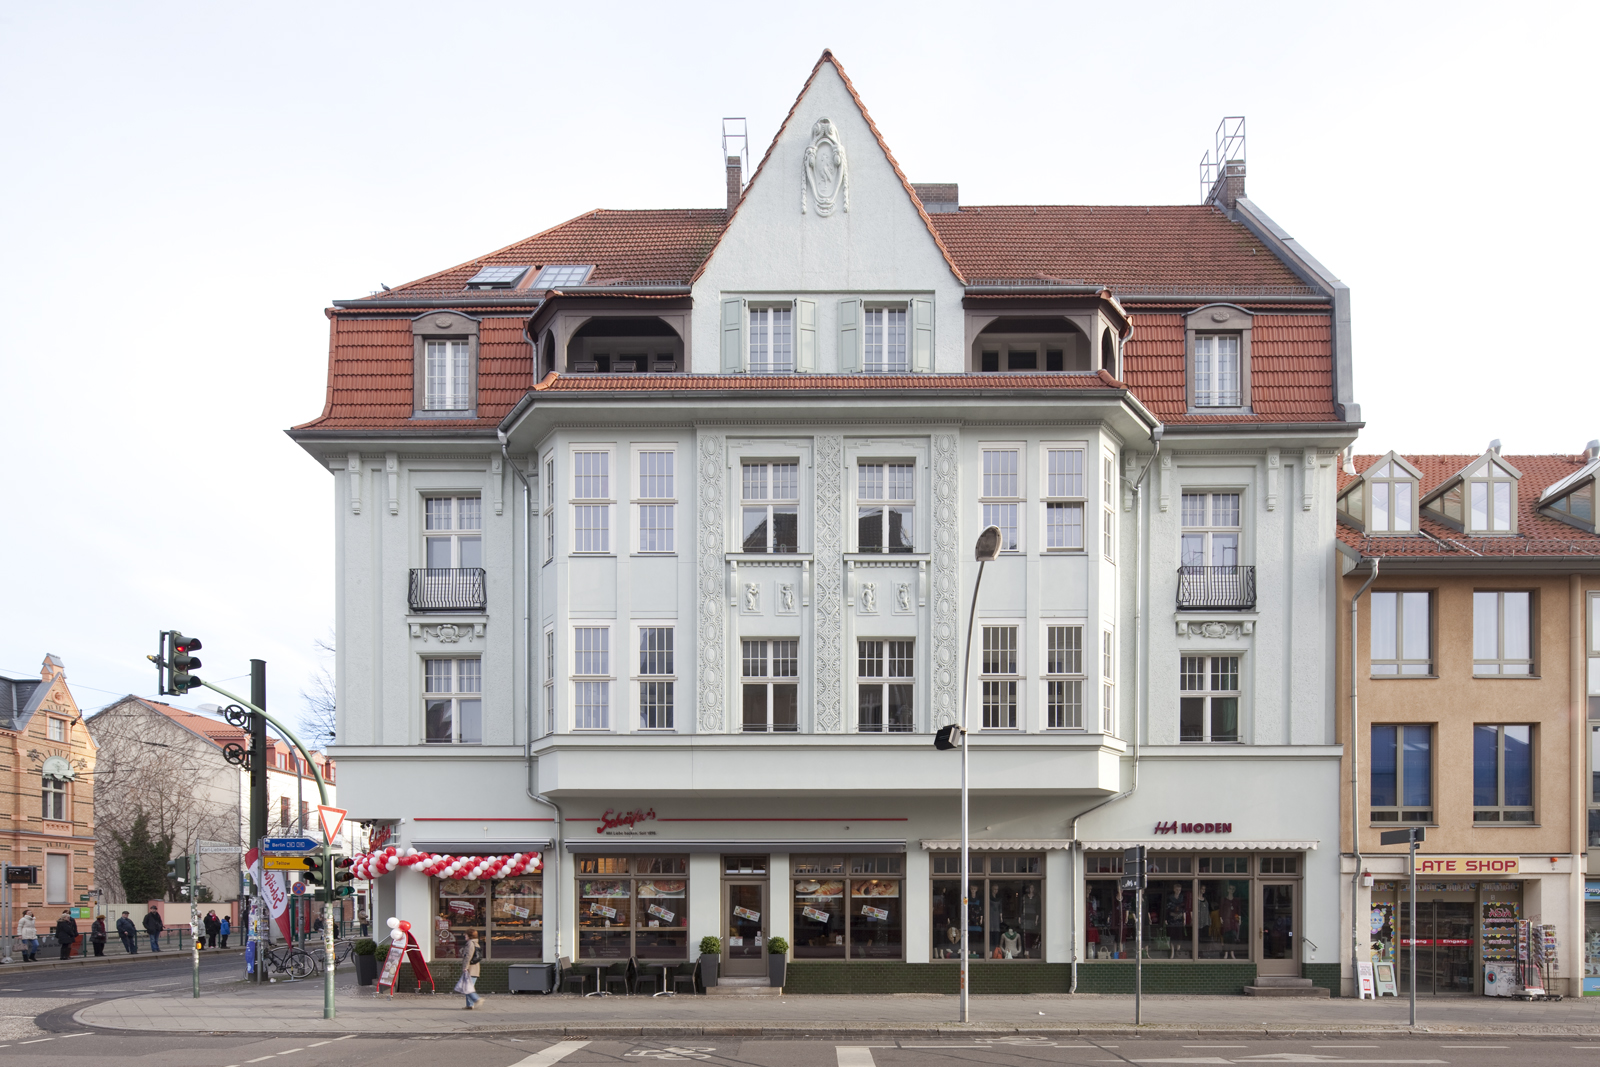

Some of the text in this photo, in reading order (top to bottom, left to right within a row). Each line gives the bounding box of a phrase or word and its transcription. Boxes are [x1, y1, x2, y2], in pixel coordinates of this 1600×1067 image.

[596, 807, 656, 834] Schäfer's
[1181, 822, 1232, 834] MODEN
[1465, 860, 1517, 872] SHOP
[1489, 907, 1512, 917] ASIA
